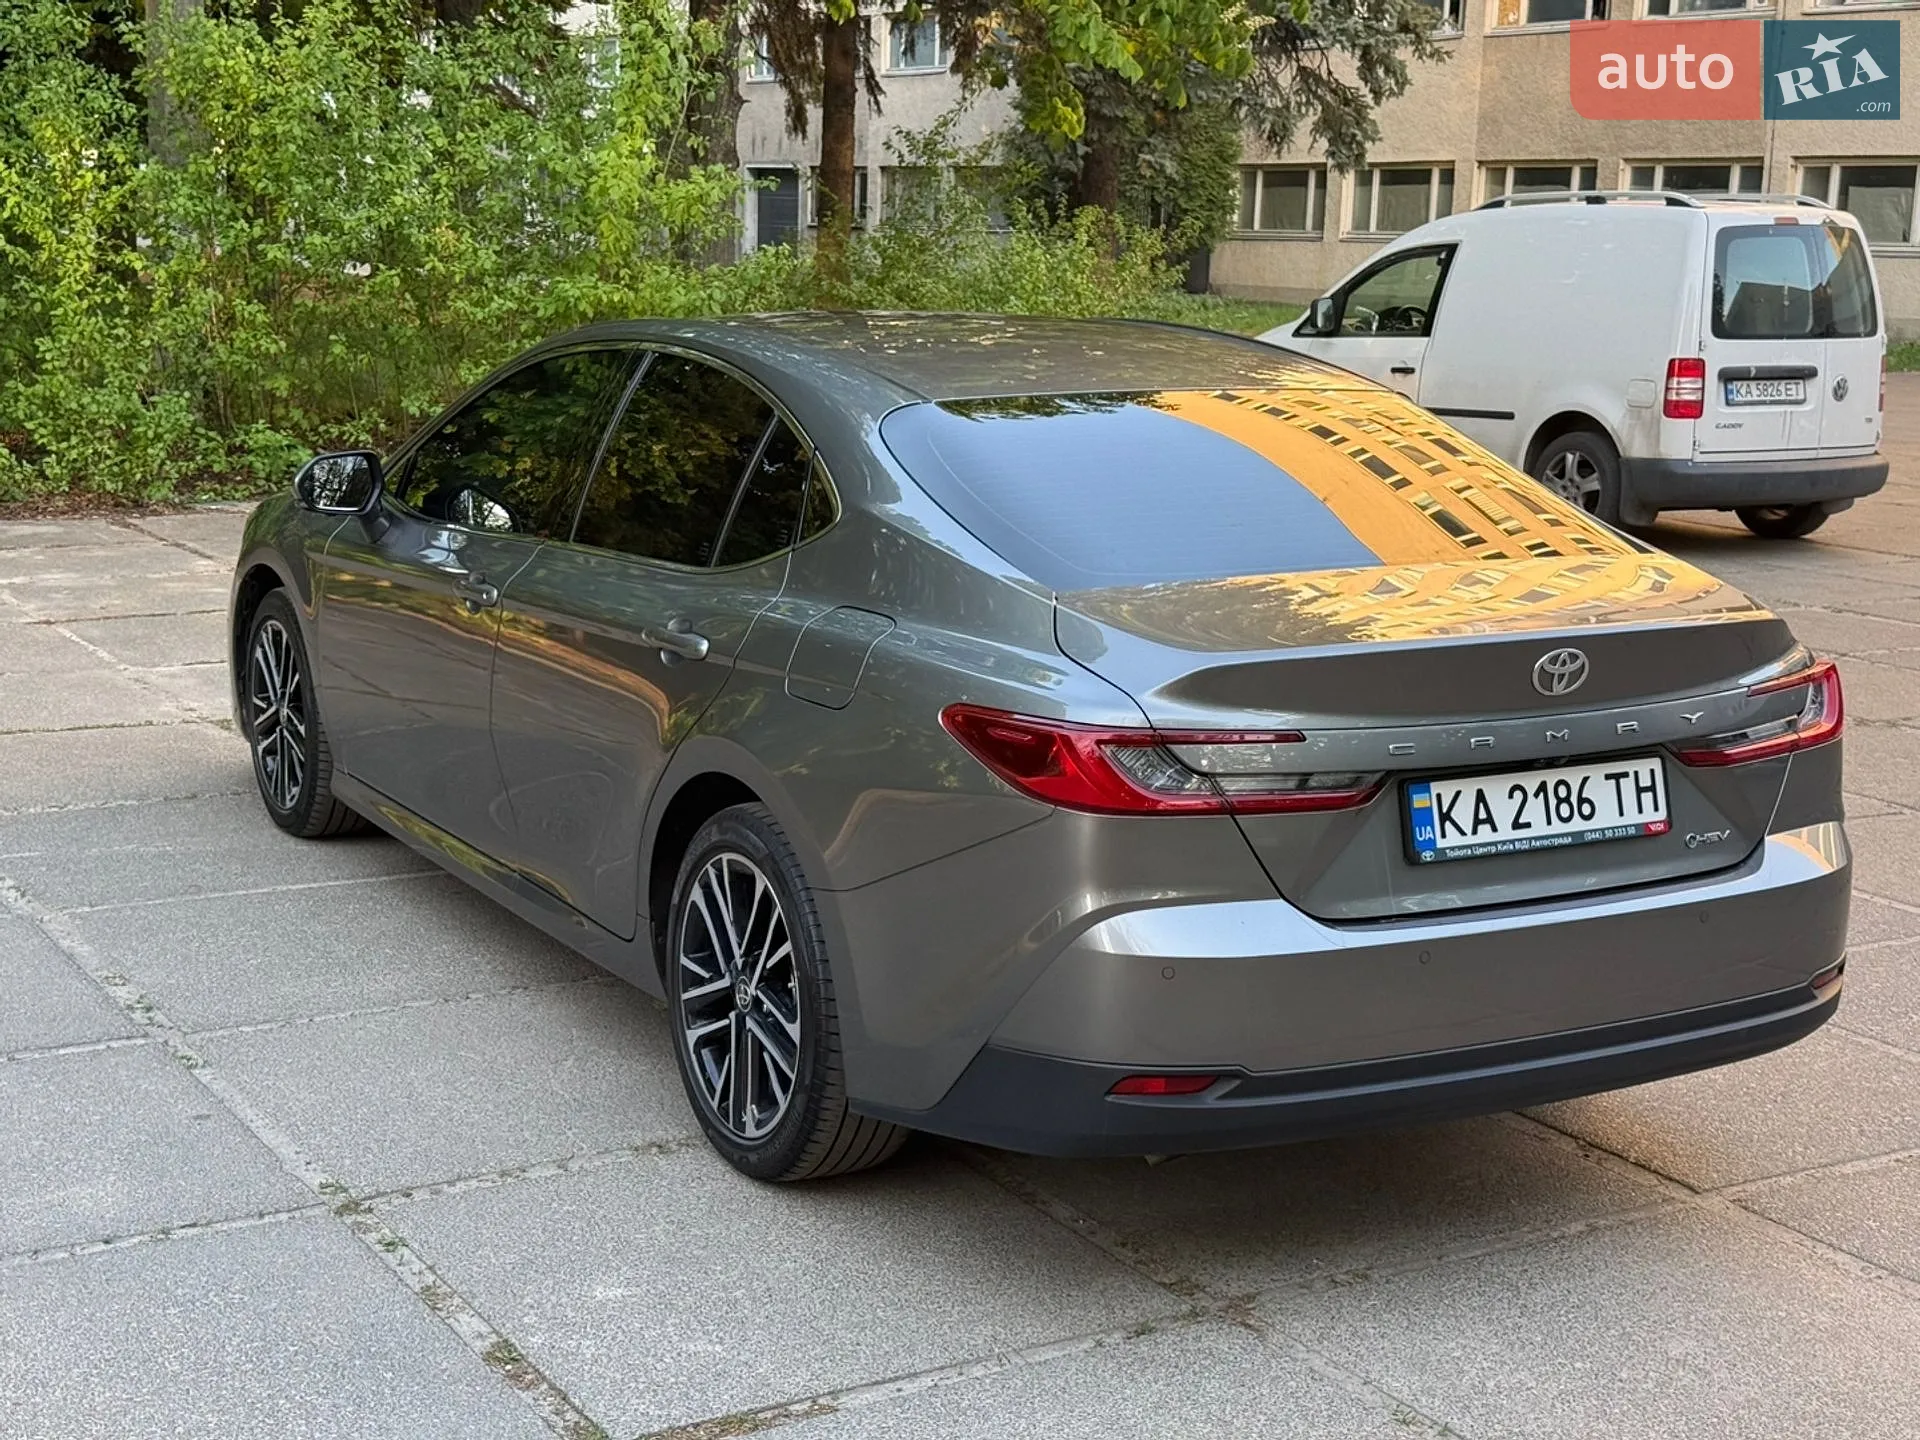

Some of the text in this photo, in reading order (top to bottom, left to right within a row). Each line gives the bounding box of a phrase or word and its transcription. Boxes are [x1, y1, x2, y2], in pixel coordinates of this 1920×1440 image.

[1735, 381, 1801, 398] KA 5826 ET
[1387, 711, 1704, 756] CAMRY
[1435, 768, 1661, 840] KA 2186 TH
[1415, 825, 1435, 841] UA
